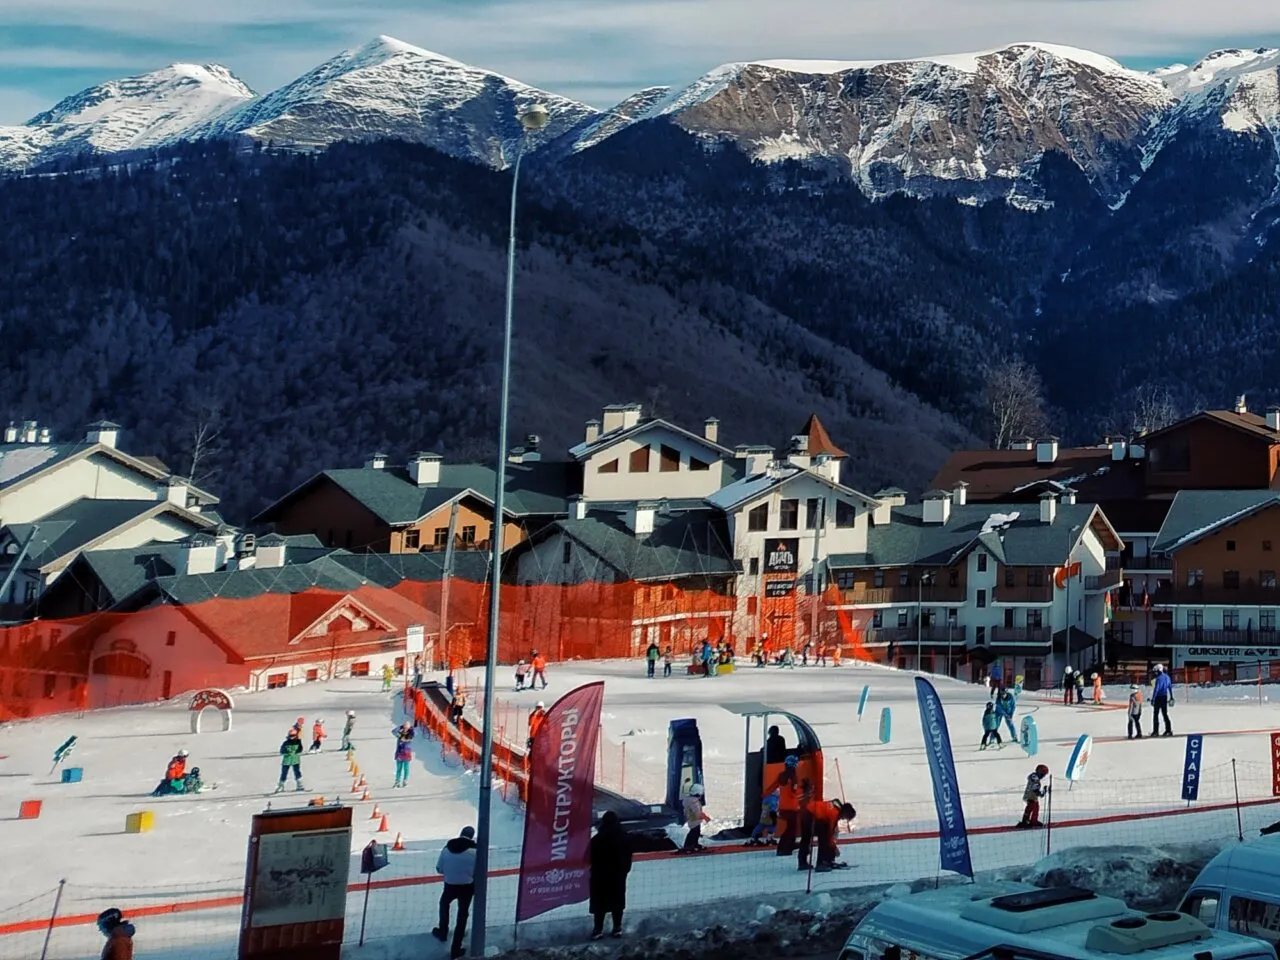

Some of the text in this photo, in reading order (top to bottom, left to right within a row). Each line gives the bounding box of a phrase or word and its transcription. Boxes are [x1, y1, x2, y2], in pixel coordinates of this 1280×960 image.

[1188, 647, 1240, 656] QUIKSILVER
[550, 708, 580, 861] ИНСТРУКТОРЫ
[1186, 739, 1200, 794] СТАРТ
